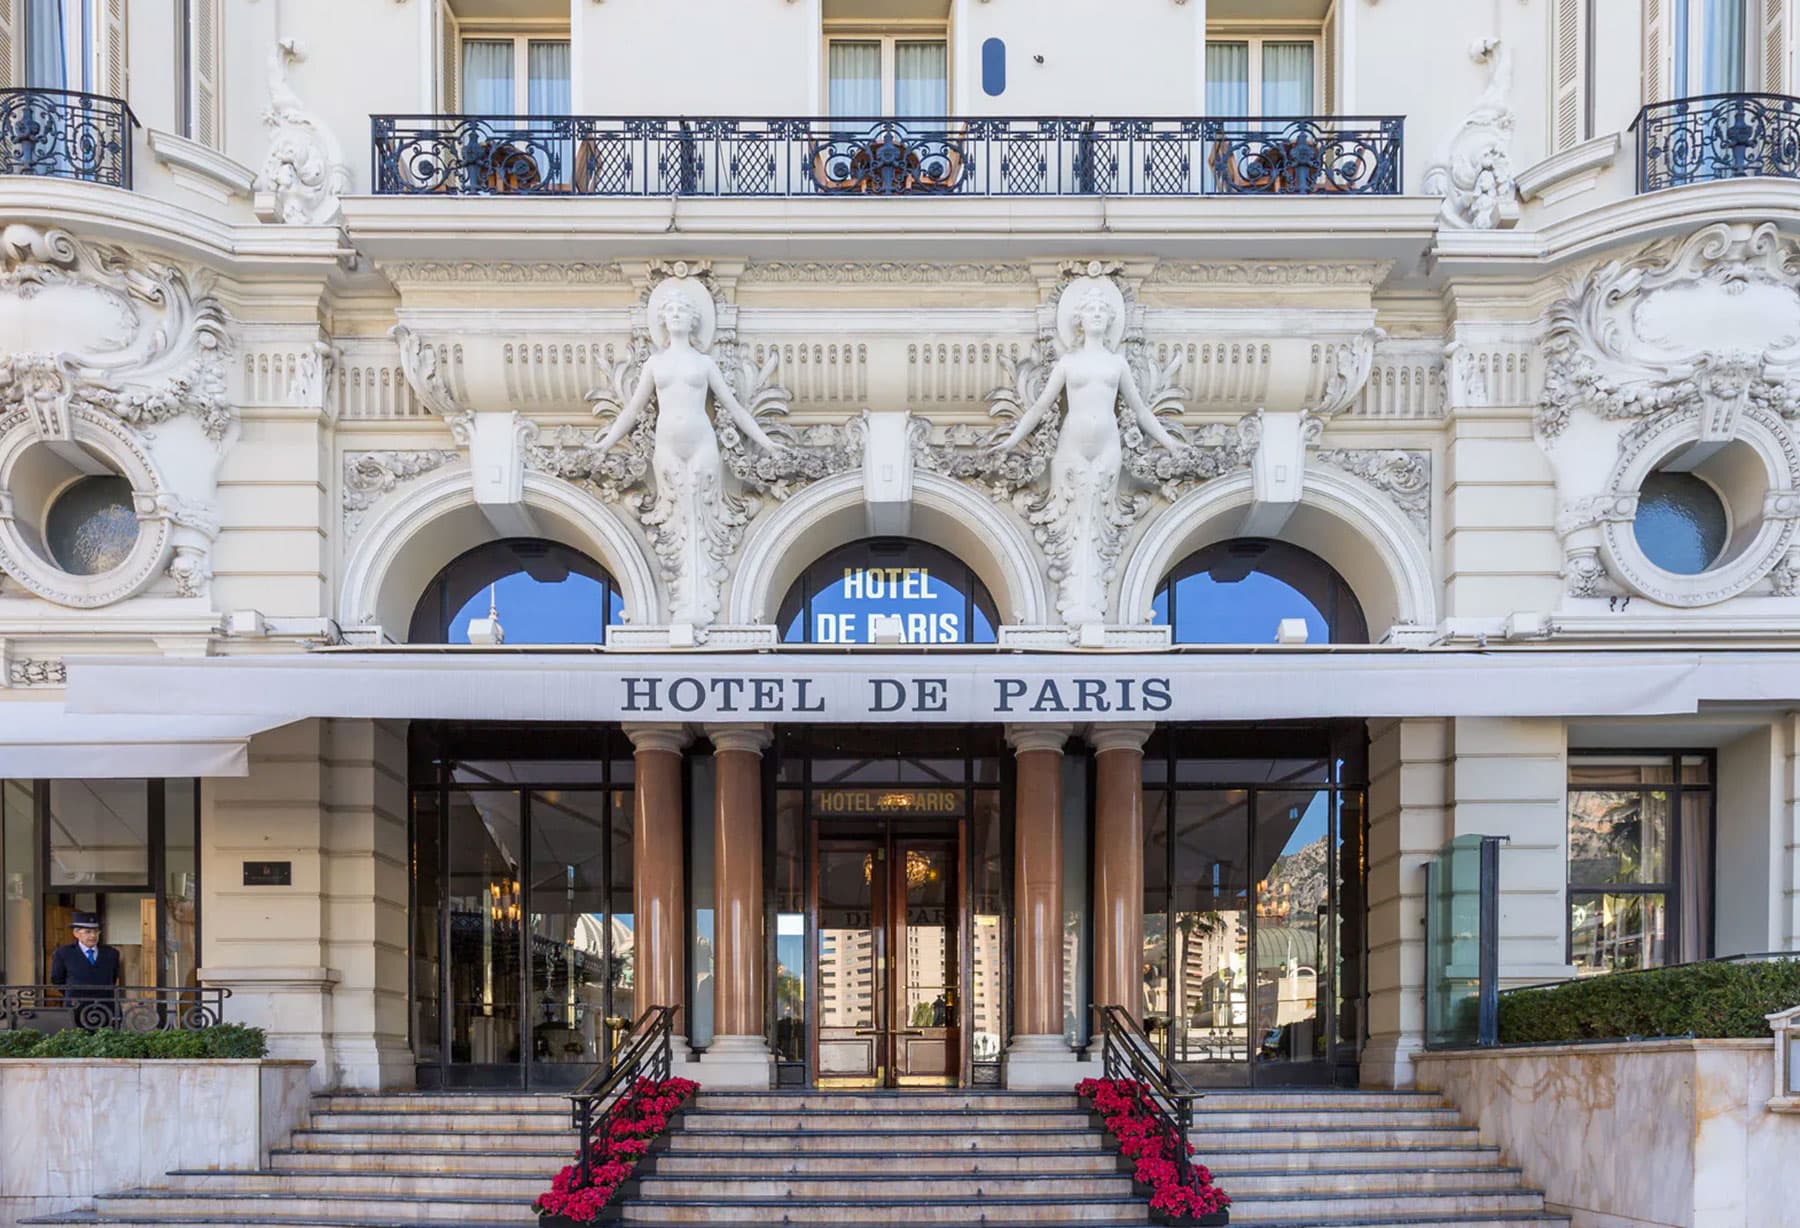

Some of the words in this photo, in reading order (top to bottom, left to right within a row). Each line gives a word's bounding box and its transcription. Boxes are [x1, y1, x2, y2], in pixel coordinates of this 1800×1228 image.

[843, 567, 937, 599] HOTEL
[817, 613, 856, 643] DE
[620, 678, 825, 712] HOTEL
[868, 678, 948, 712] DE
[993, 678, 1174, 712] PARIS
[820, 792, 875, 812] HOTEL
